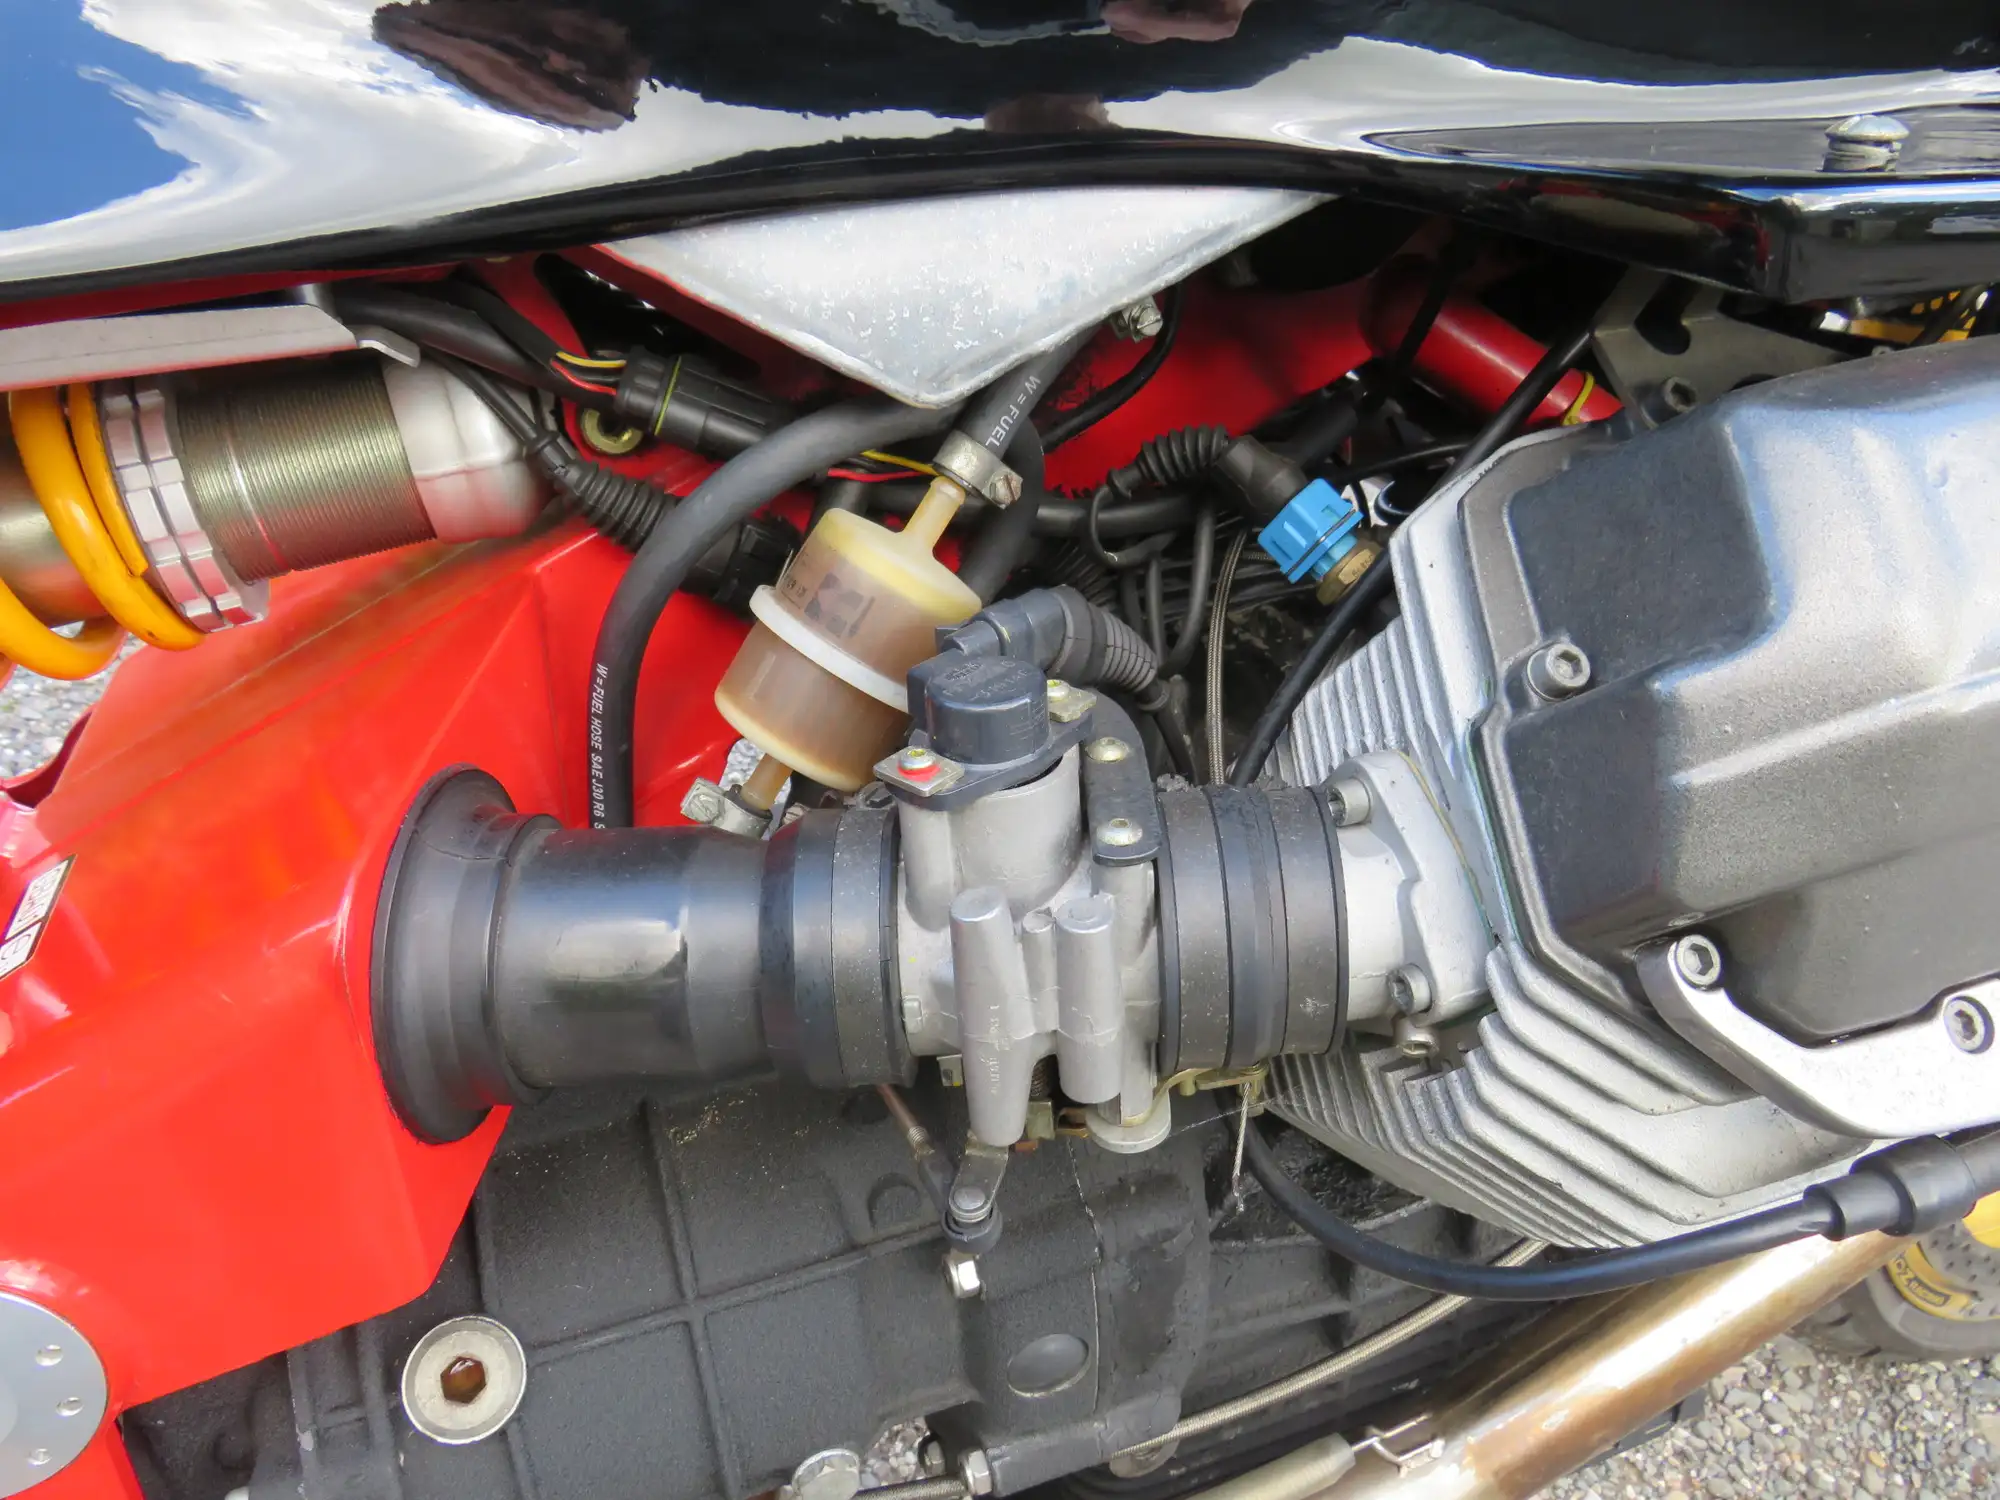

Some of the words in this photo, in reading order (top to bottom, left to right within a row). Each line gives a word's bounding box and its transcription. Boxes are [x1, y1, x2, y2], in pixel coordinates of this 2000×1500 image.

[1024, 375, 1041, 395] W
[985, 404, 1020, 447] FUEL
[591, 715, 602, 751] HOSE
[591, 753, 603, 779] SAE
